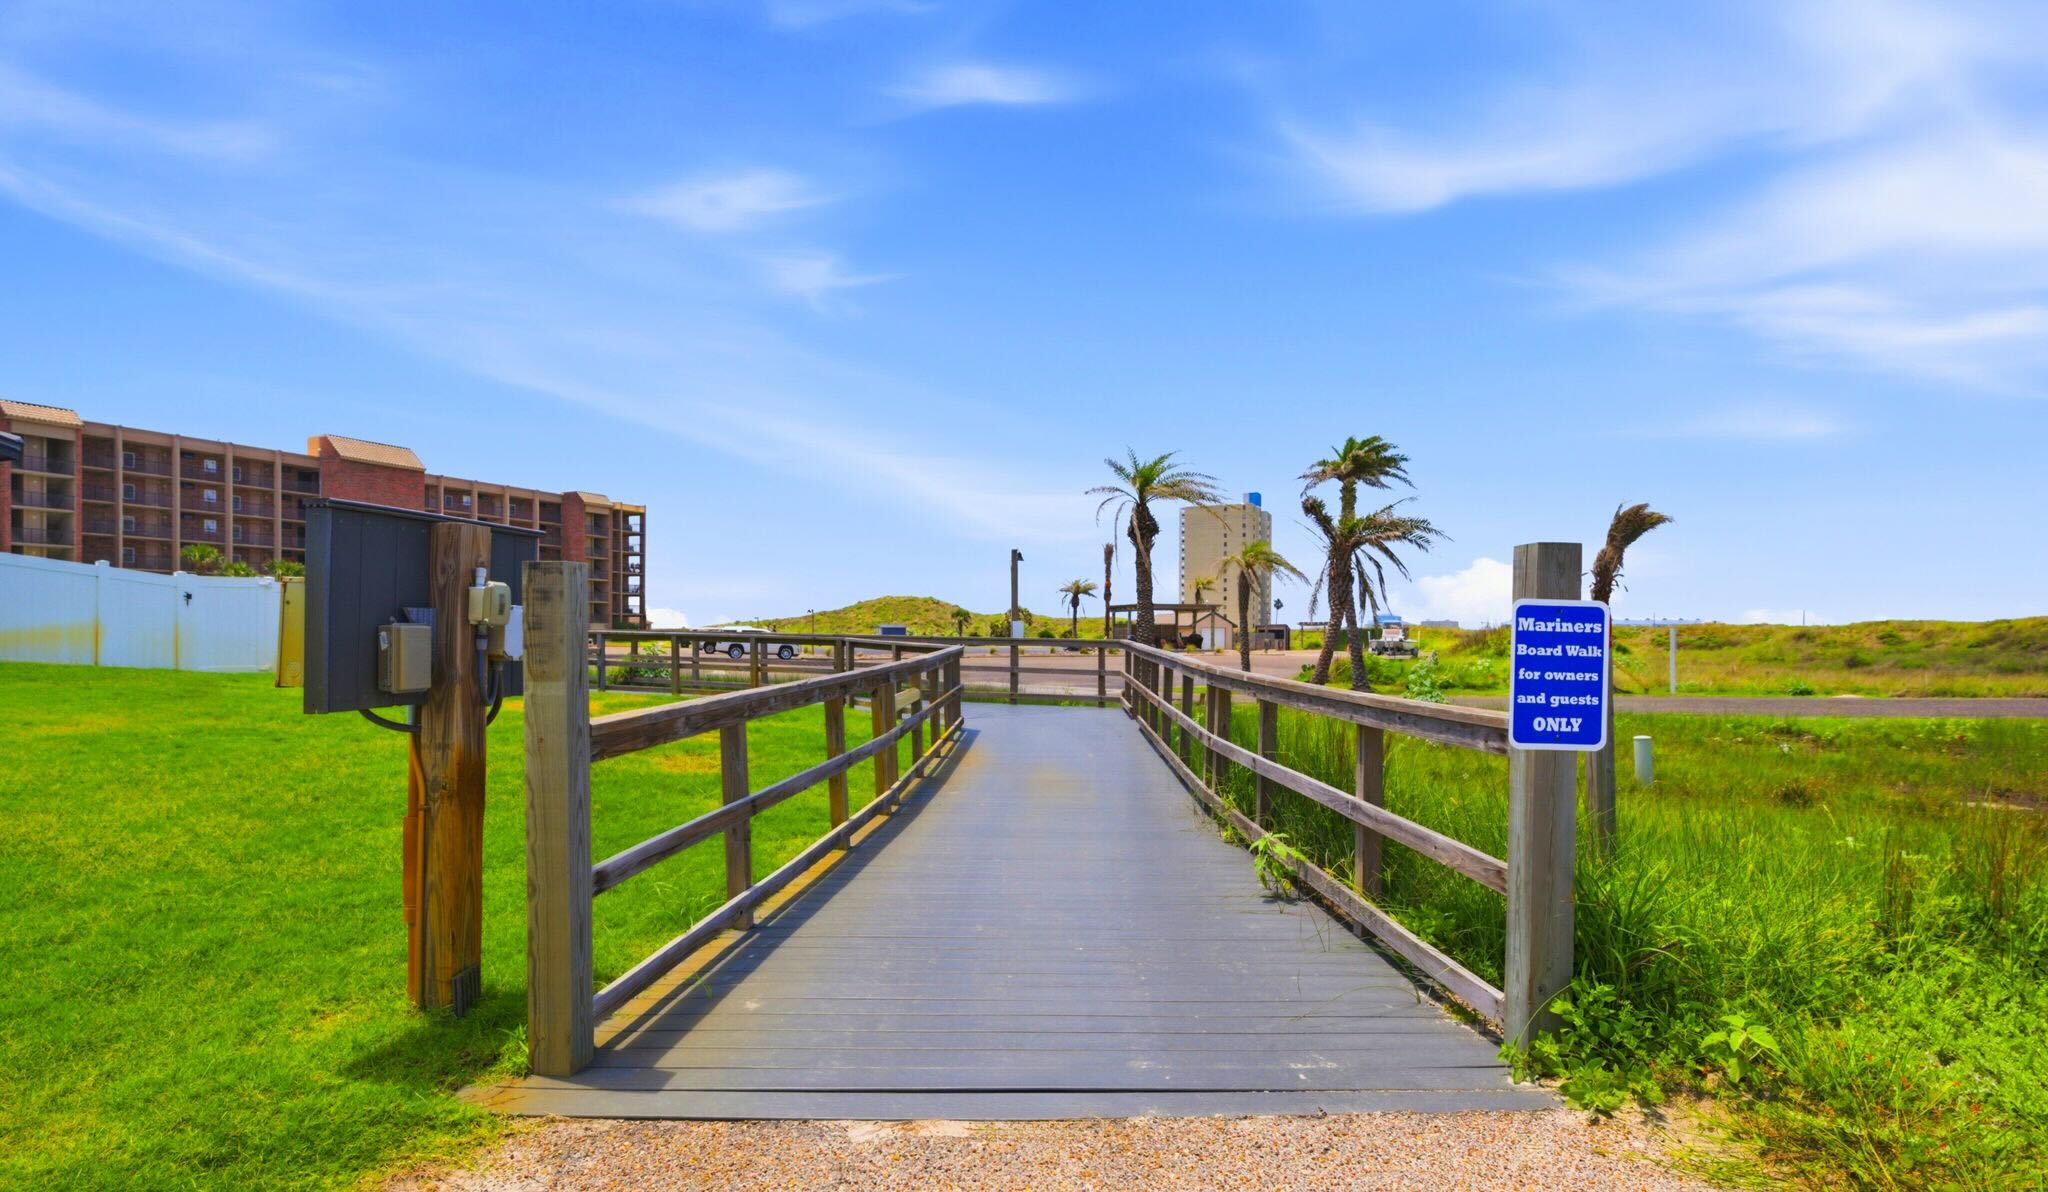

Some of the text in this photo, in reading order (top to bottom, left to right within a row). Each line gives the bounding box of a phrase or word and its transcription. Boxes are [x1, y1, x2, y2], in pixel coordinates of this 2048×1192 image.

[1518, 617, 1602, 633] Mariners
[1517, 644, 1602, 657] Board Walk
[1518, 668, 1599, 681] for owners
[1517, 693, 1599, 708] and guests
[1533, 717, 1583, 732] ONLY
